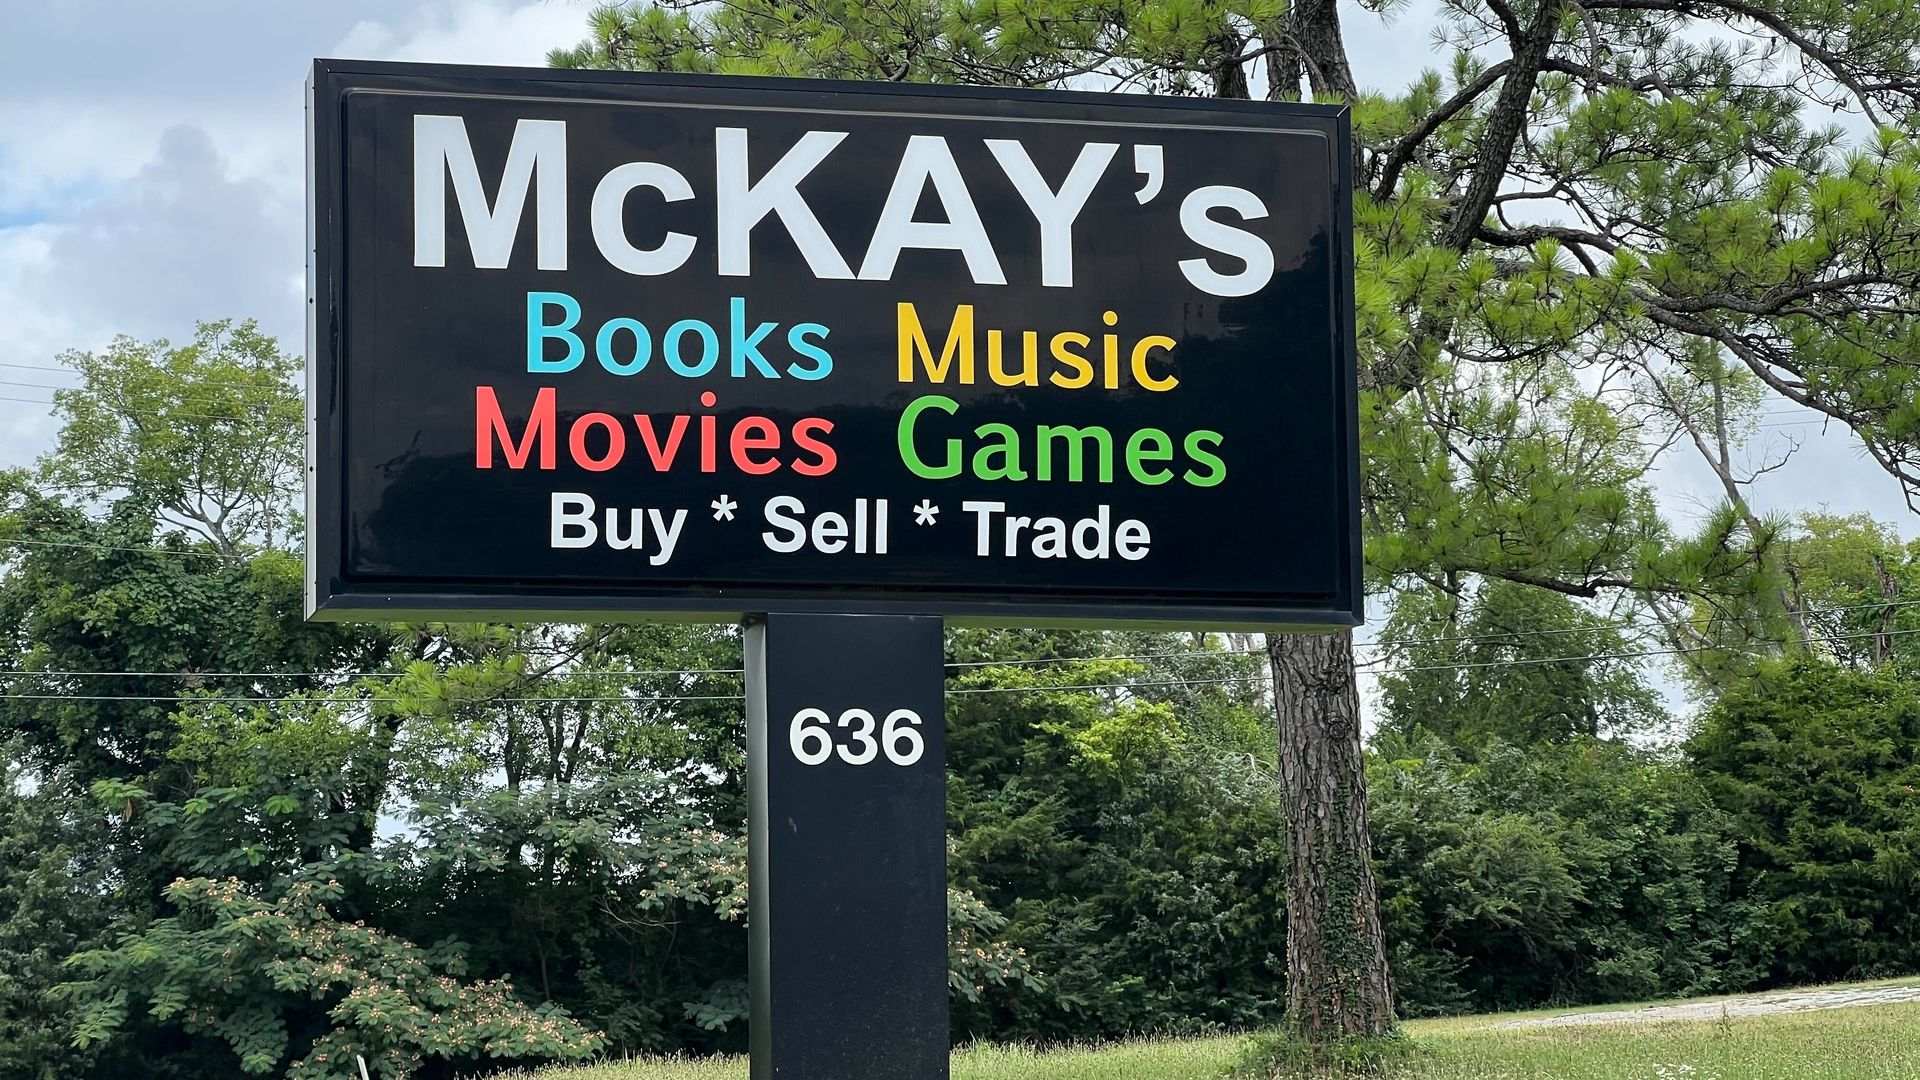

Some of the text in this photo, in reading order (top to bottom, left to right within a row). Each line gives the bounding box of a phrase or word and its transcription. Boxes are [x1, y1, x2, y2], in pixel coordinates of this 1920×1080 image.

[413, 114, 1275, 298] McKAY's
[526, 291, 1179, 393] Books Music
[476, 386, 1227, 487] Movies Games
[550, 492, 689, 566] Buy
[761, 495, 888, 557] Sell
[962, 500, 1151, 562] Trade
[789, 707, 925, 766] 636
